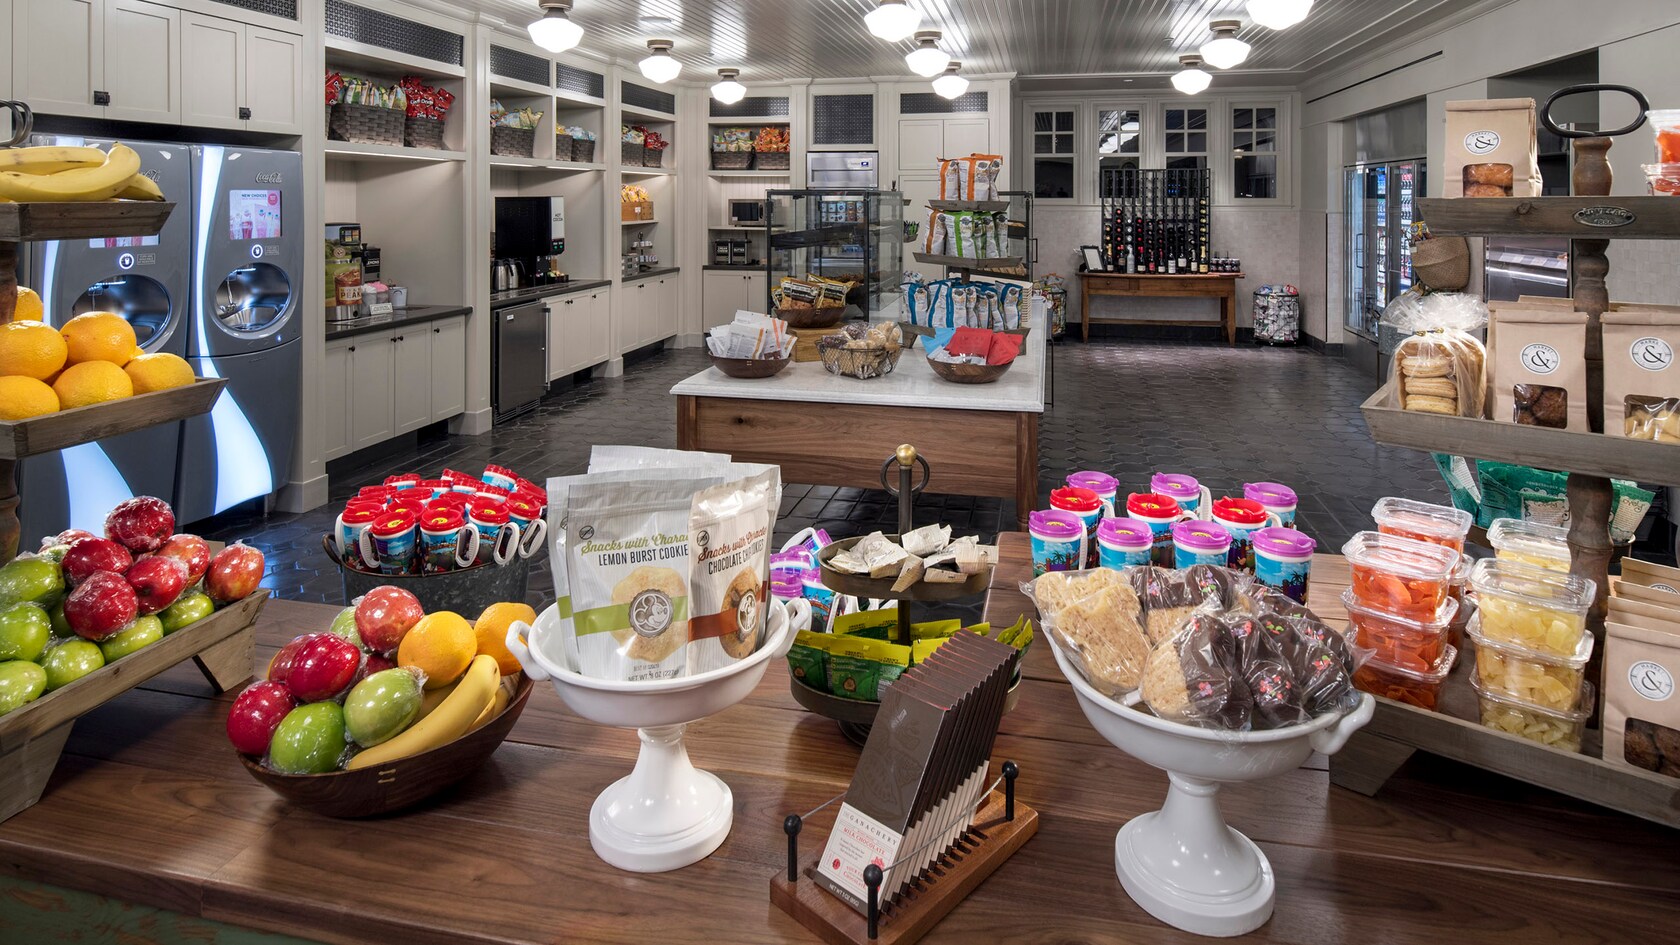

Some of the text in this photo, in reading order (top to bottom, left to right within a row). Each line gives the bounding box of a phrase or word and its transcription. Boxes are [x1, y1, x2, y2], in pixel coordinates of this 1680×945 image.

[1474, 136, 1495, 149] &
[1531, 350, 1551, 369] &
[1643, 345, 1666, 363] &
[581, 540, 623, 556] Snacks
[624, 536, 649, 550] with
[698, 544, 731, 564] Snacks
[598, 552, 627, 566] LEMON
[630, 549, 657, 563] BURST
[708, 552, 742, 575] CHOCOLATE
[1642, 670, 1666, 694] &
[849, 815, 897, 845] GANACHERY
[856, 835, 886, 855] CHOCOLATE
